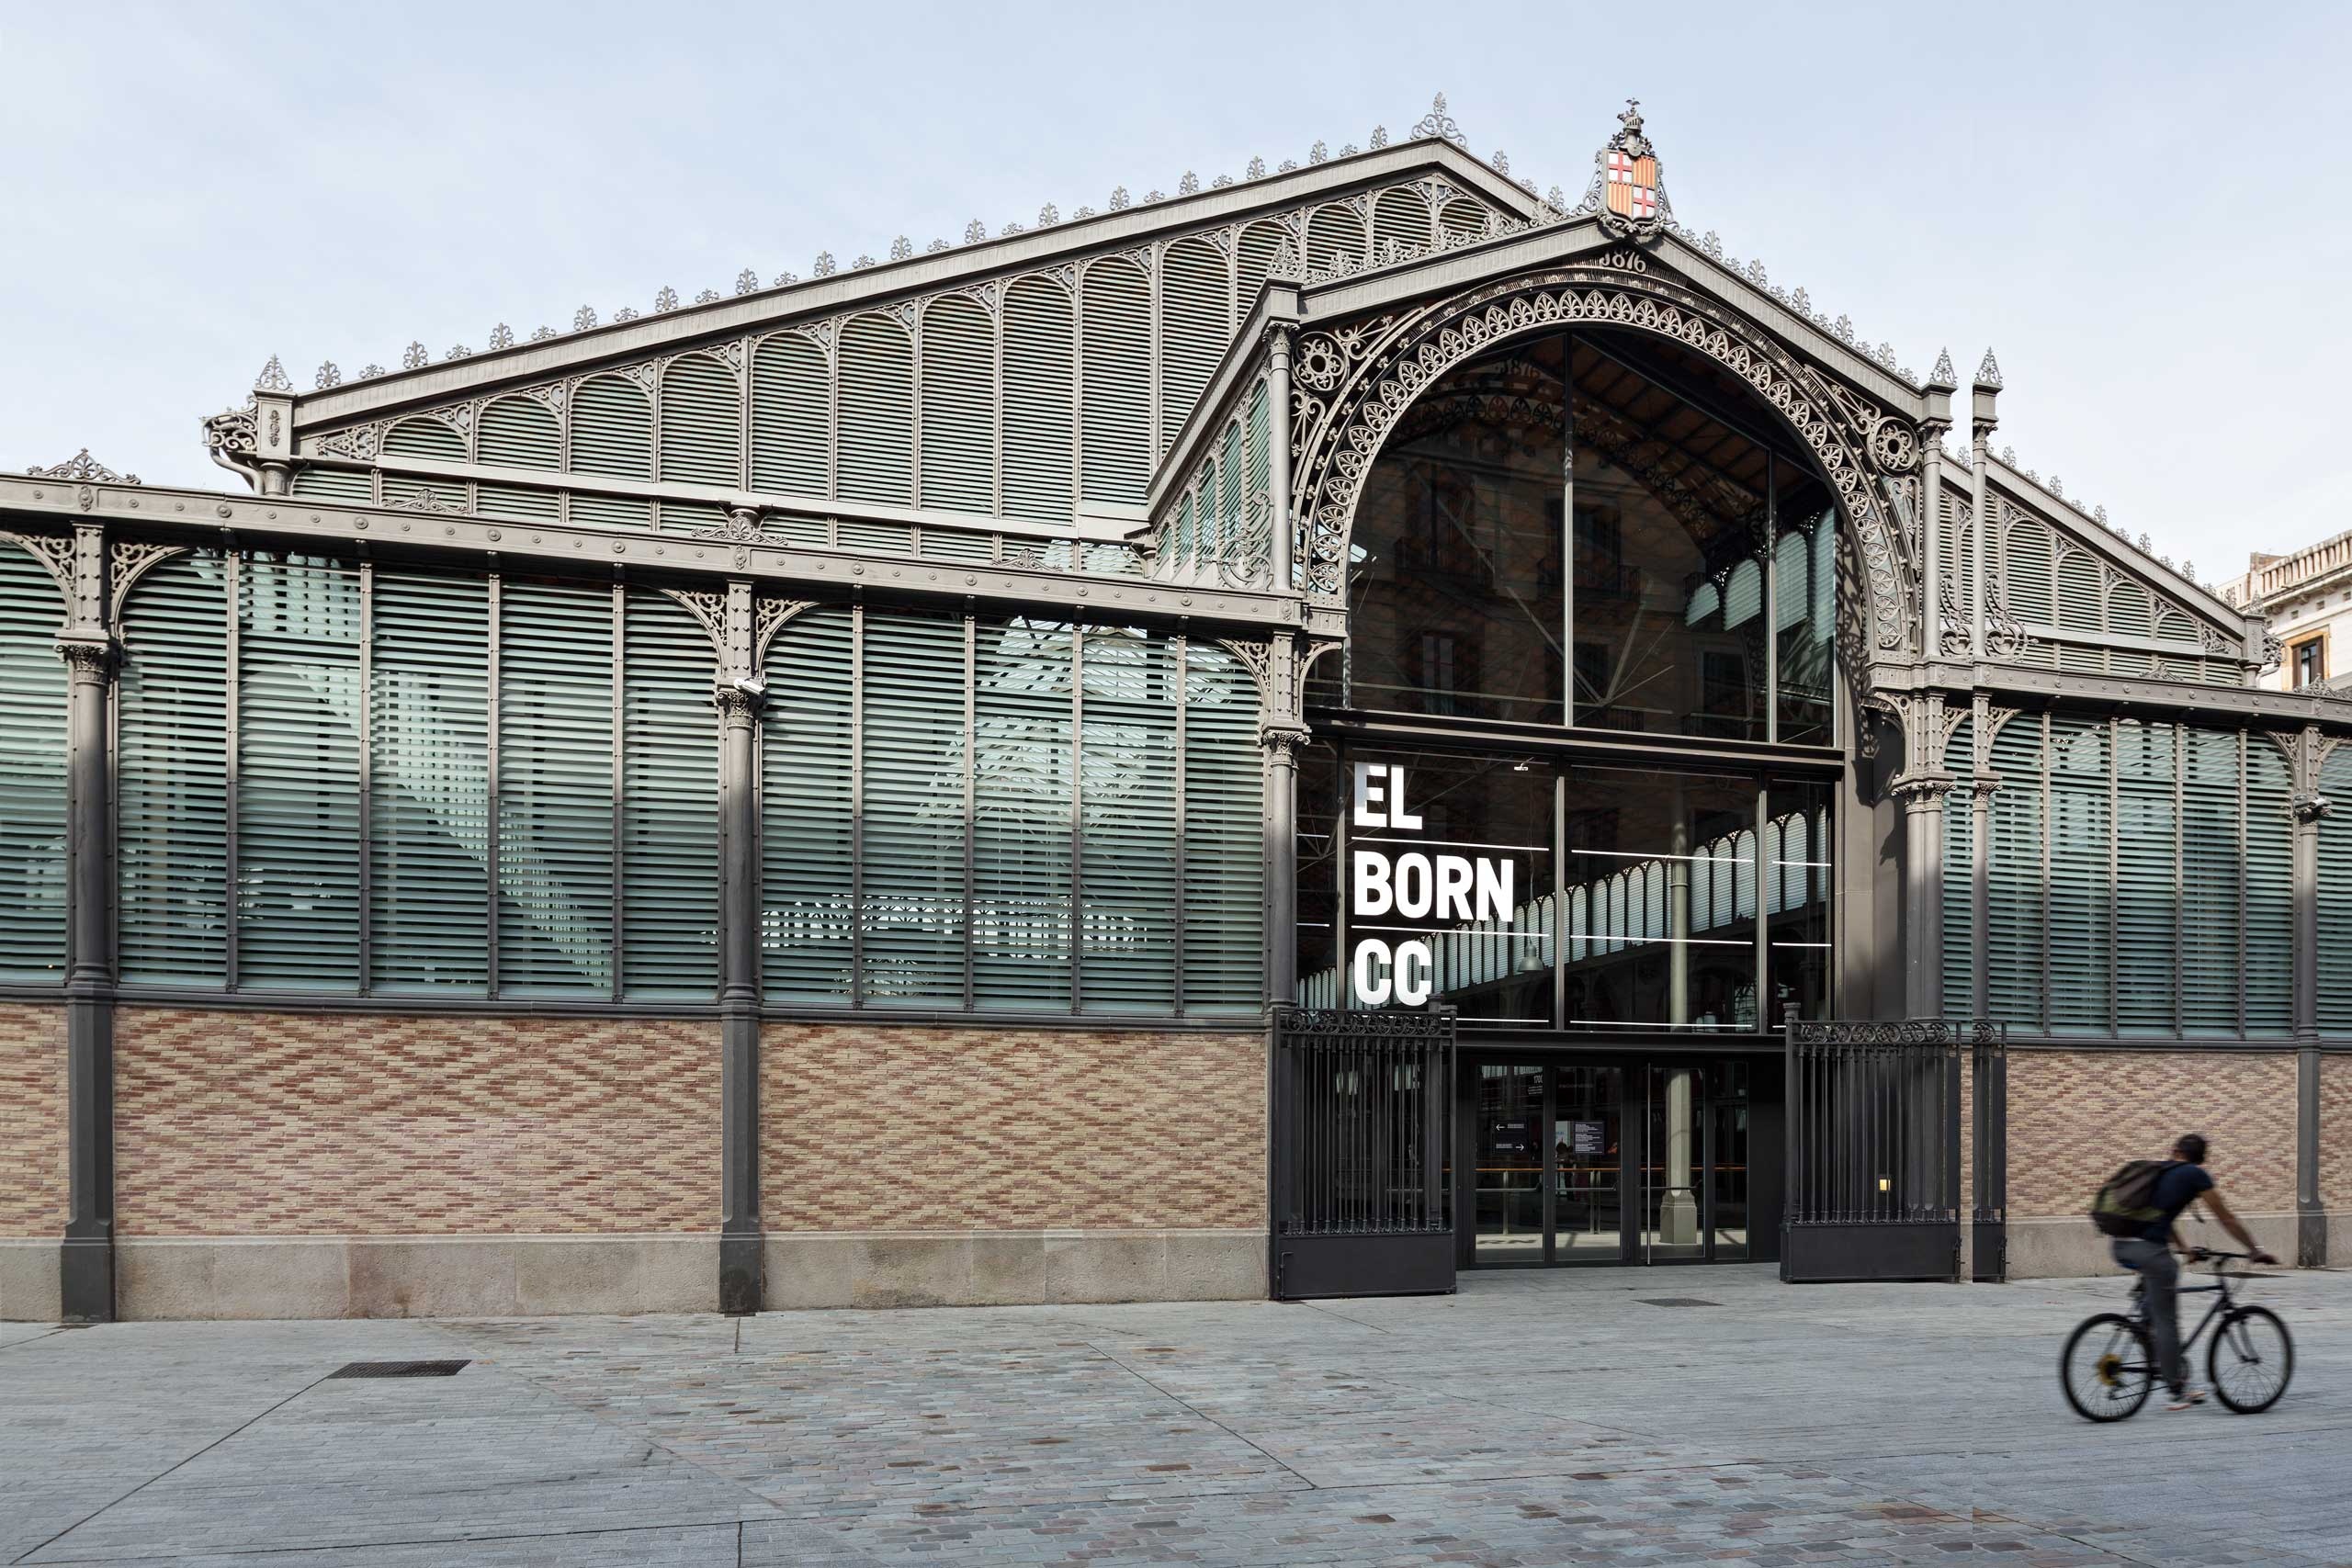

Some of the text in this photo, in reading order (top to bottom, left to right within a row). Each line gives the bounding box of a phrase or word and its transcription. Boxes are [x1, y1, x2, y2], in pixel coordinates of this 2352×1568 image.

[1599, 248, 1646, 273] 1876
[1354, 761, 1422, 829] EL
[1354, 851, 1514, 922] BORN
[1354, 939, 1432, 1006] CC
